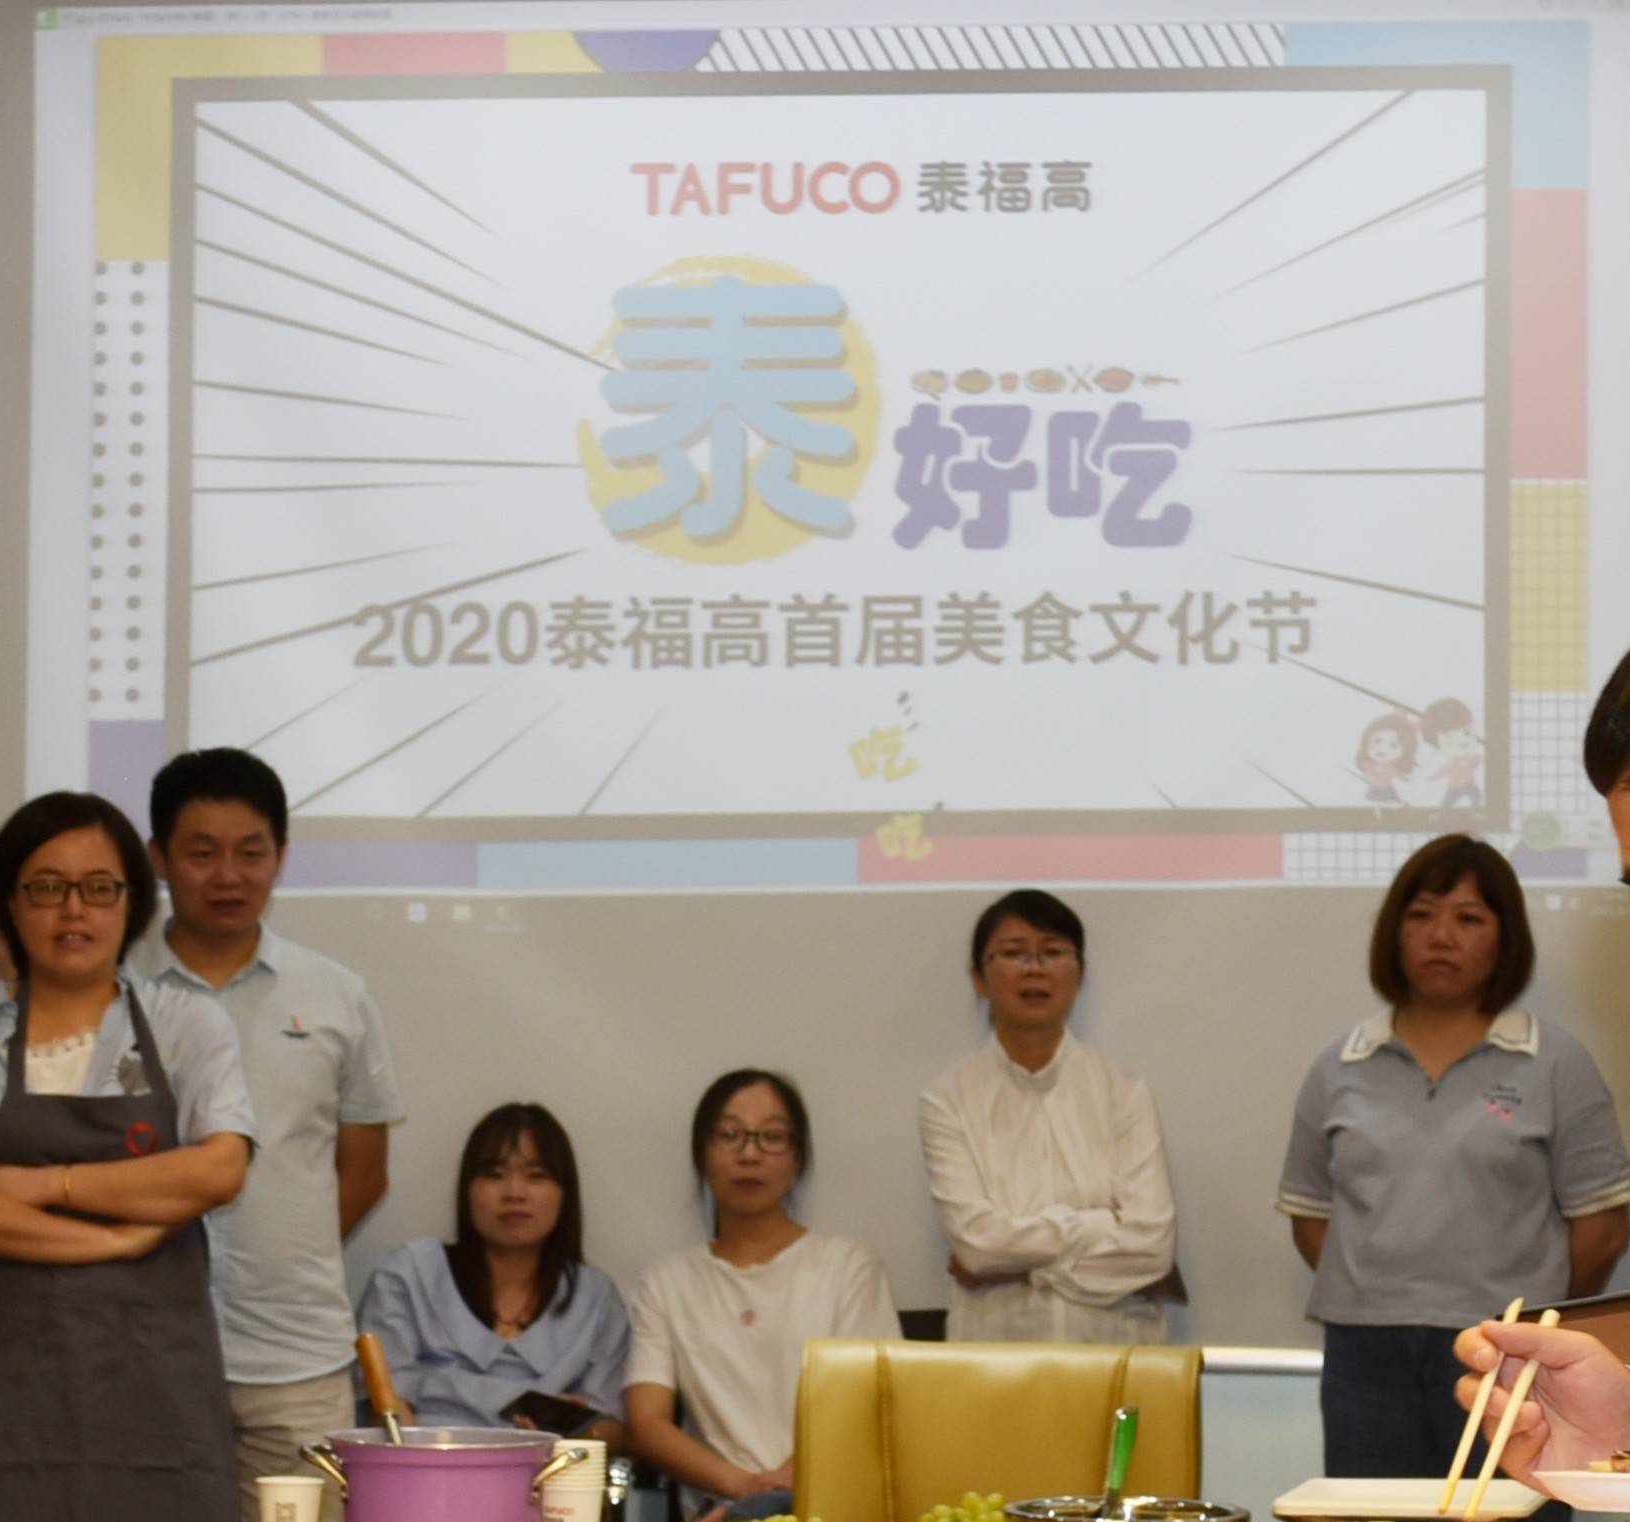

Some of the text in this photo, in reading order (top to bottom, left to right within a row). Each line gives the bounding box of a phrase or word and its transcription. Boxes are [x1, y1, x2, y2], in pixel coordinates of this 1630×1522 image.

[631, 160, 1092, 216] TAFUCO 泰福高
[352, 591, 1318, 671] 2020泰福高首届美食文化节
